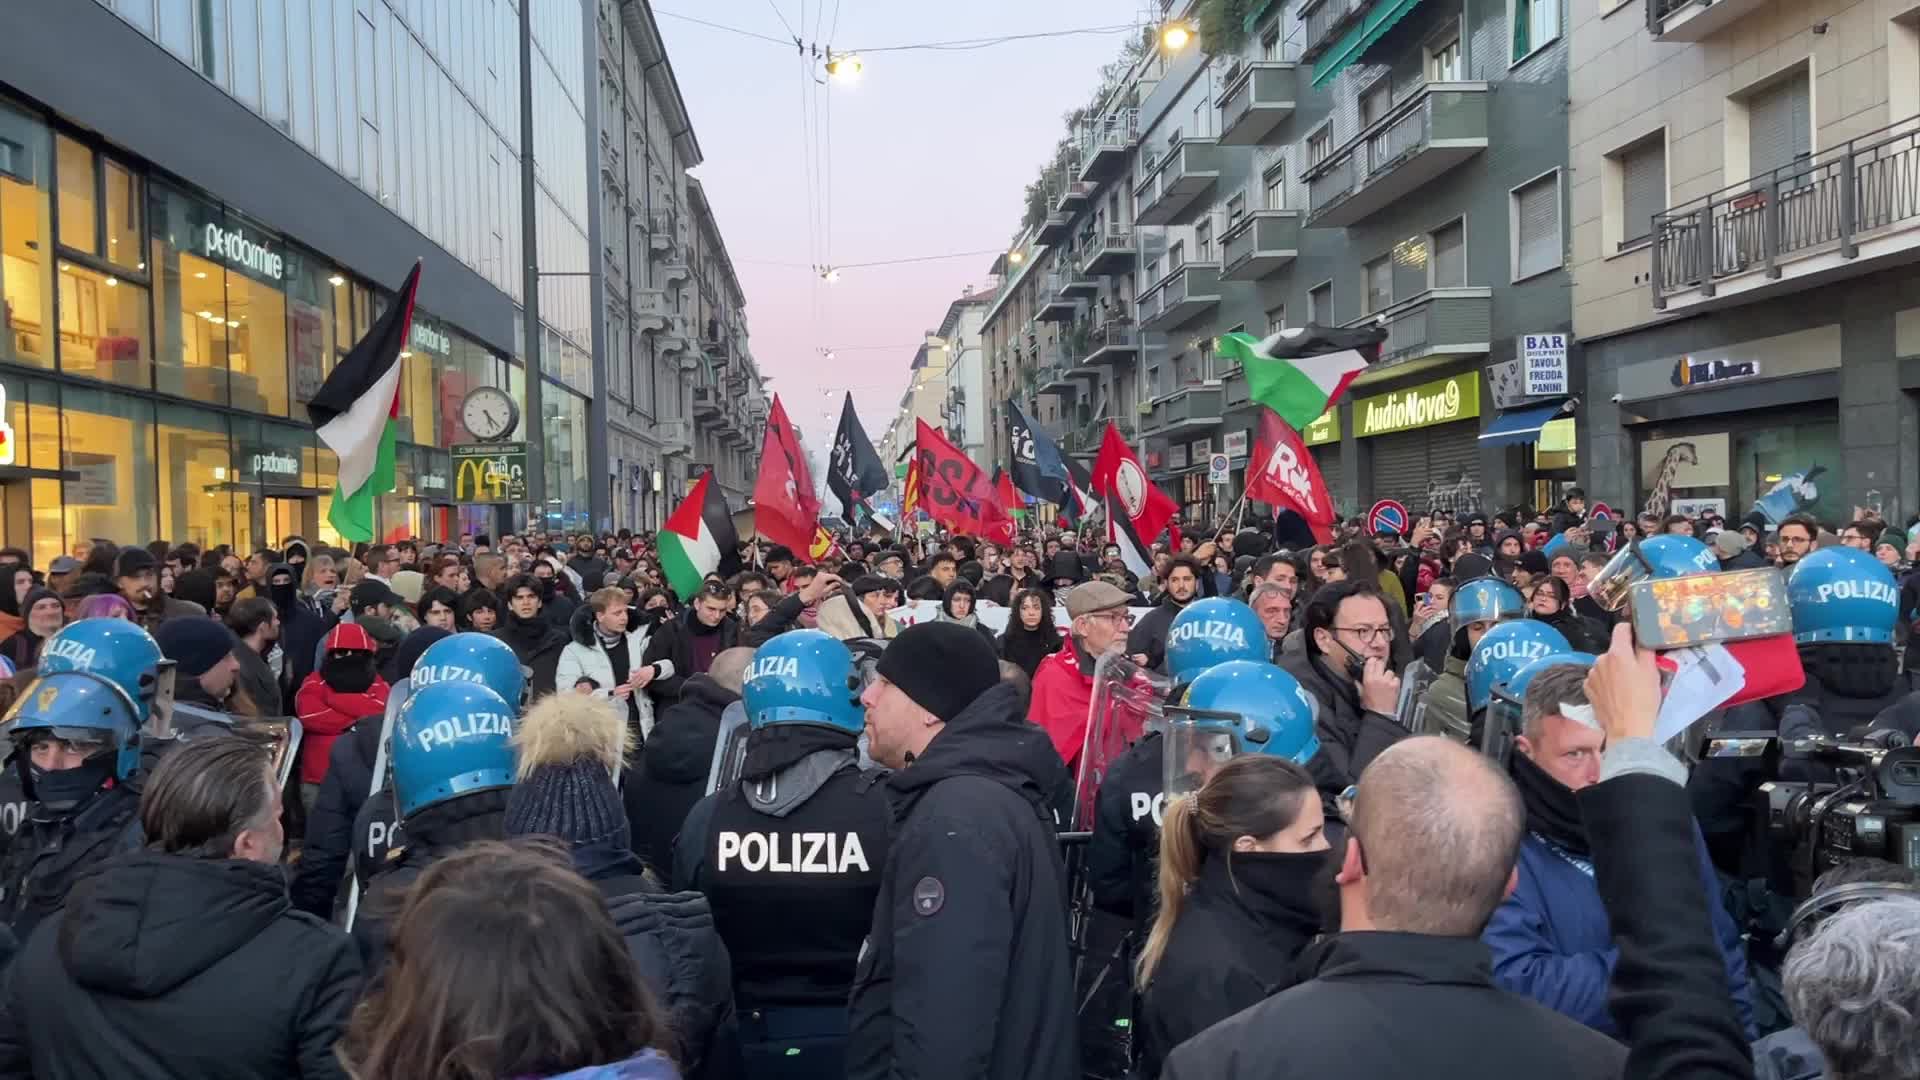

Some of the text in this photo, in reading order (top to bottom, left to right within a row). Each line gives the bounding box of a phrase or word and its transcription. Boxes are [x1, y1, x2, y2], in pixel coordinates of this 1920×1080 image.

[206, 223, 283, 279] perdormire
[1526, 335, 1564, 349] BAR
[1529, 370, 1563, 381] FREDDA
[1530, 358, 1562, 368] TAVOLA
[1532, 383, 1562, 393] PANINI
[1364, 391, 1446, 433] AudioNova
[1817, 579, 1897, 607] POLIZIA
[1170, 620, 1244, 647] POLIZIA
[1481, 639, 1551, 666] POLIZI
[743, 655, 798, 685] OLIZIA
[417, 712, 513, 752] POLIZIA
[718, 831, 870, 873] POLIZIA
